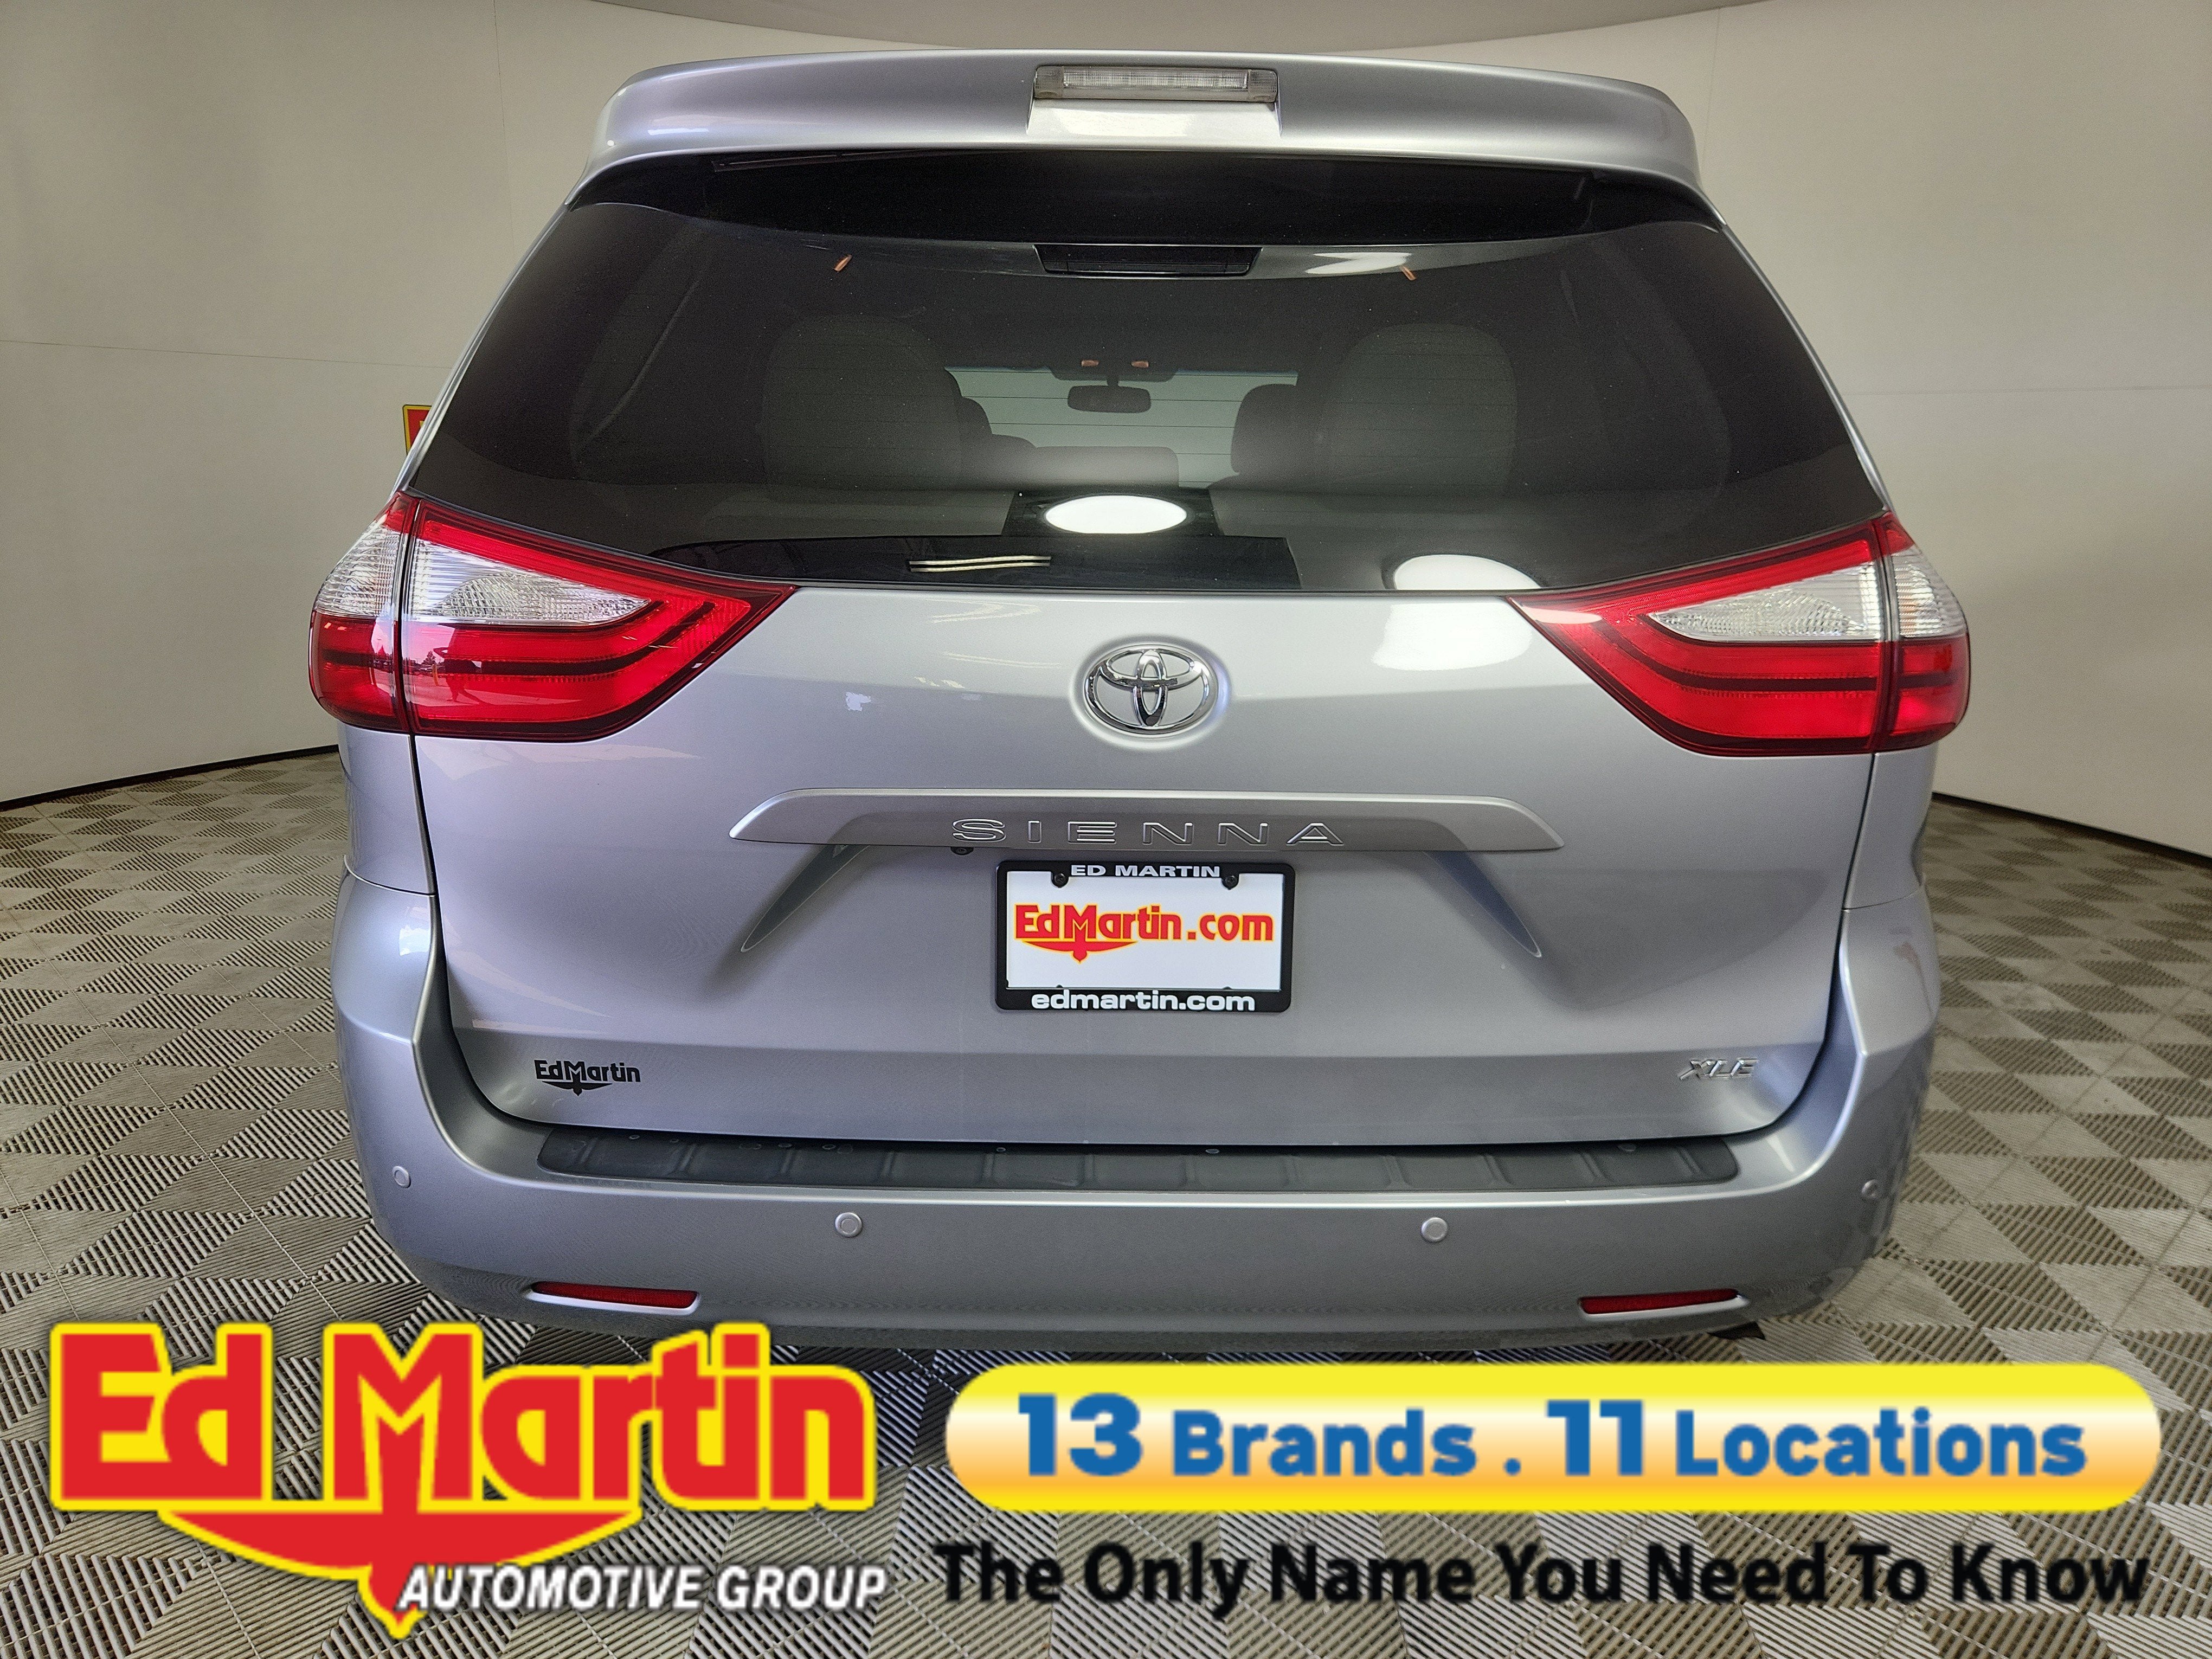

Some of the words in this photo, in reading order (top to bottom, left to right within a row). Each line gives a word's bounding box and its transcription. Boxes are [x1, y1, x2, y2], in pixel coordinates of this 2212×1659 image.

[953, 818, 1343, 847] SIENNA
[1071, 865, 1105, 878] ED
[1115, 865, 1220, 878] MARTIN
[1032, 990, 1255, 1012] edmartin.com
[1679, 1058, 1759, 1080] XLE
